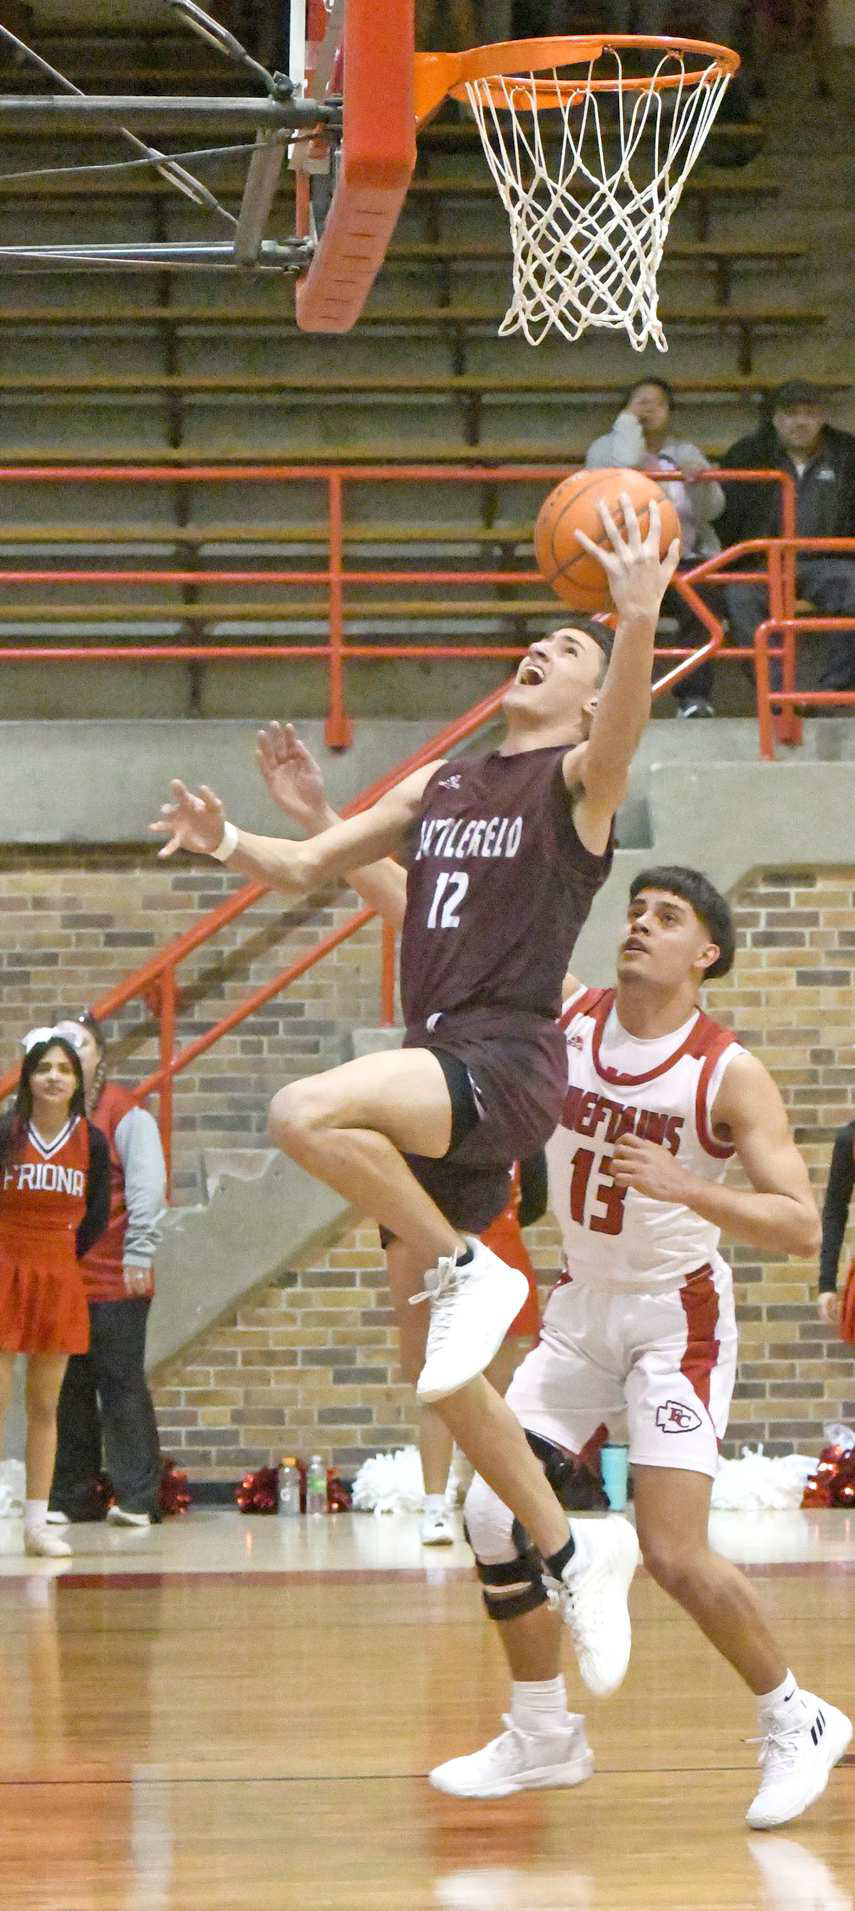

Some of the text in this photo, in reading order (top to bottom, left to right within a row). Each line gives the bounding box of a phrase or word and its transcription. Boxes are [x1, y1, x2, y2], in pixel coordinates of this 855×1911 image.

[427, 871, 469, 928] 12
[3, 1162, 84, 1197] FRIONA
[570, 1147, 629, 1236] 13
